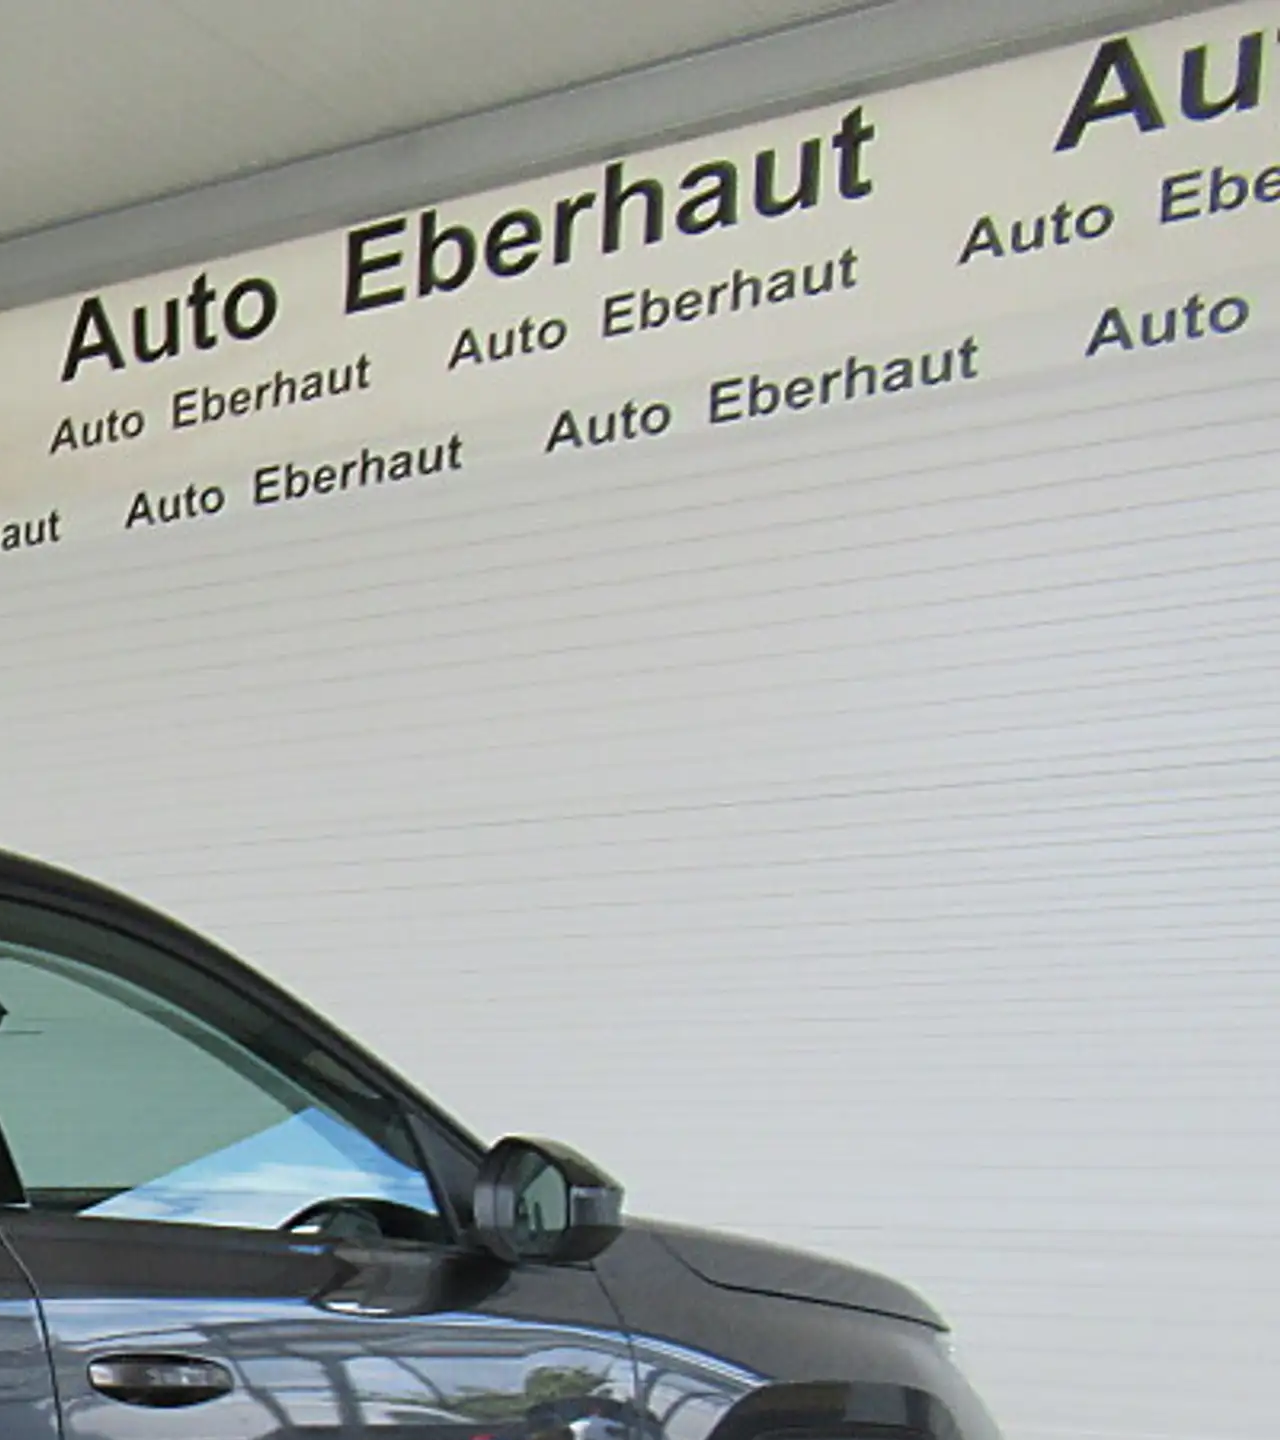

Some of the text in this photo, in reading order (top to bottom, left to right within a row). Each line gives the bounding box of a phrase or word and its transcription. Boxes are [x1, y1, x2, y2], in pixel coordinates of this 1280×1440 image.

[1053, 28, 1280, 153] Au
[60, 104, 876, 384] Auto Eberhaut
[958, 202, 1115, 265] Auto
[447, 247, 859, 371] Auto Eberhaut
[1084, 293, 1249, 357] Auto
[49, 353, 371, 456] Auto Eberhaut
[544, 337, 979, 454] Auto Eberhaut
[124, 433, 463, 530] Auto Eberhaut
